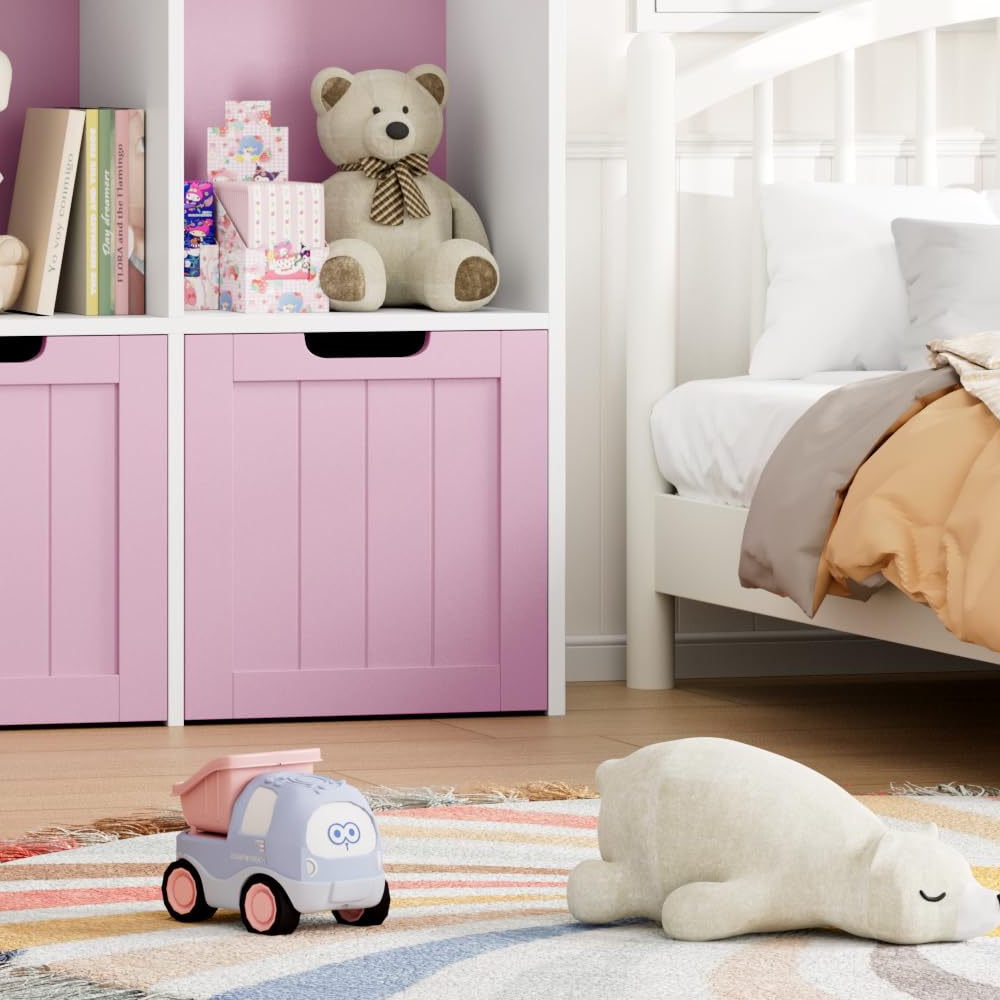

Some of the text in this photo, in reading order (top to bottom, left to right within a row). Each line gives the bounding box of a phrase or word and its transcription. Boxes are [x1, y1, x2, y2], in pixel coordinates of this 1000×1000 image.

[101, 169, 112, 256] Day dreamers
[48, 254, 58, 273] Yo
